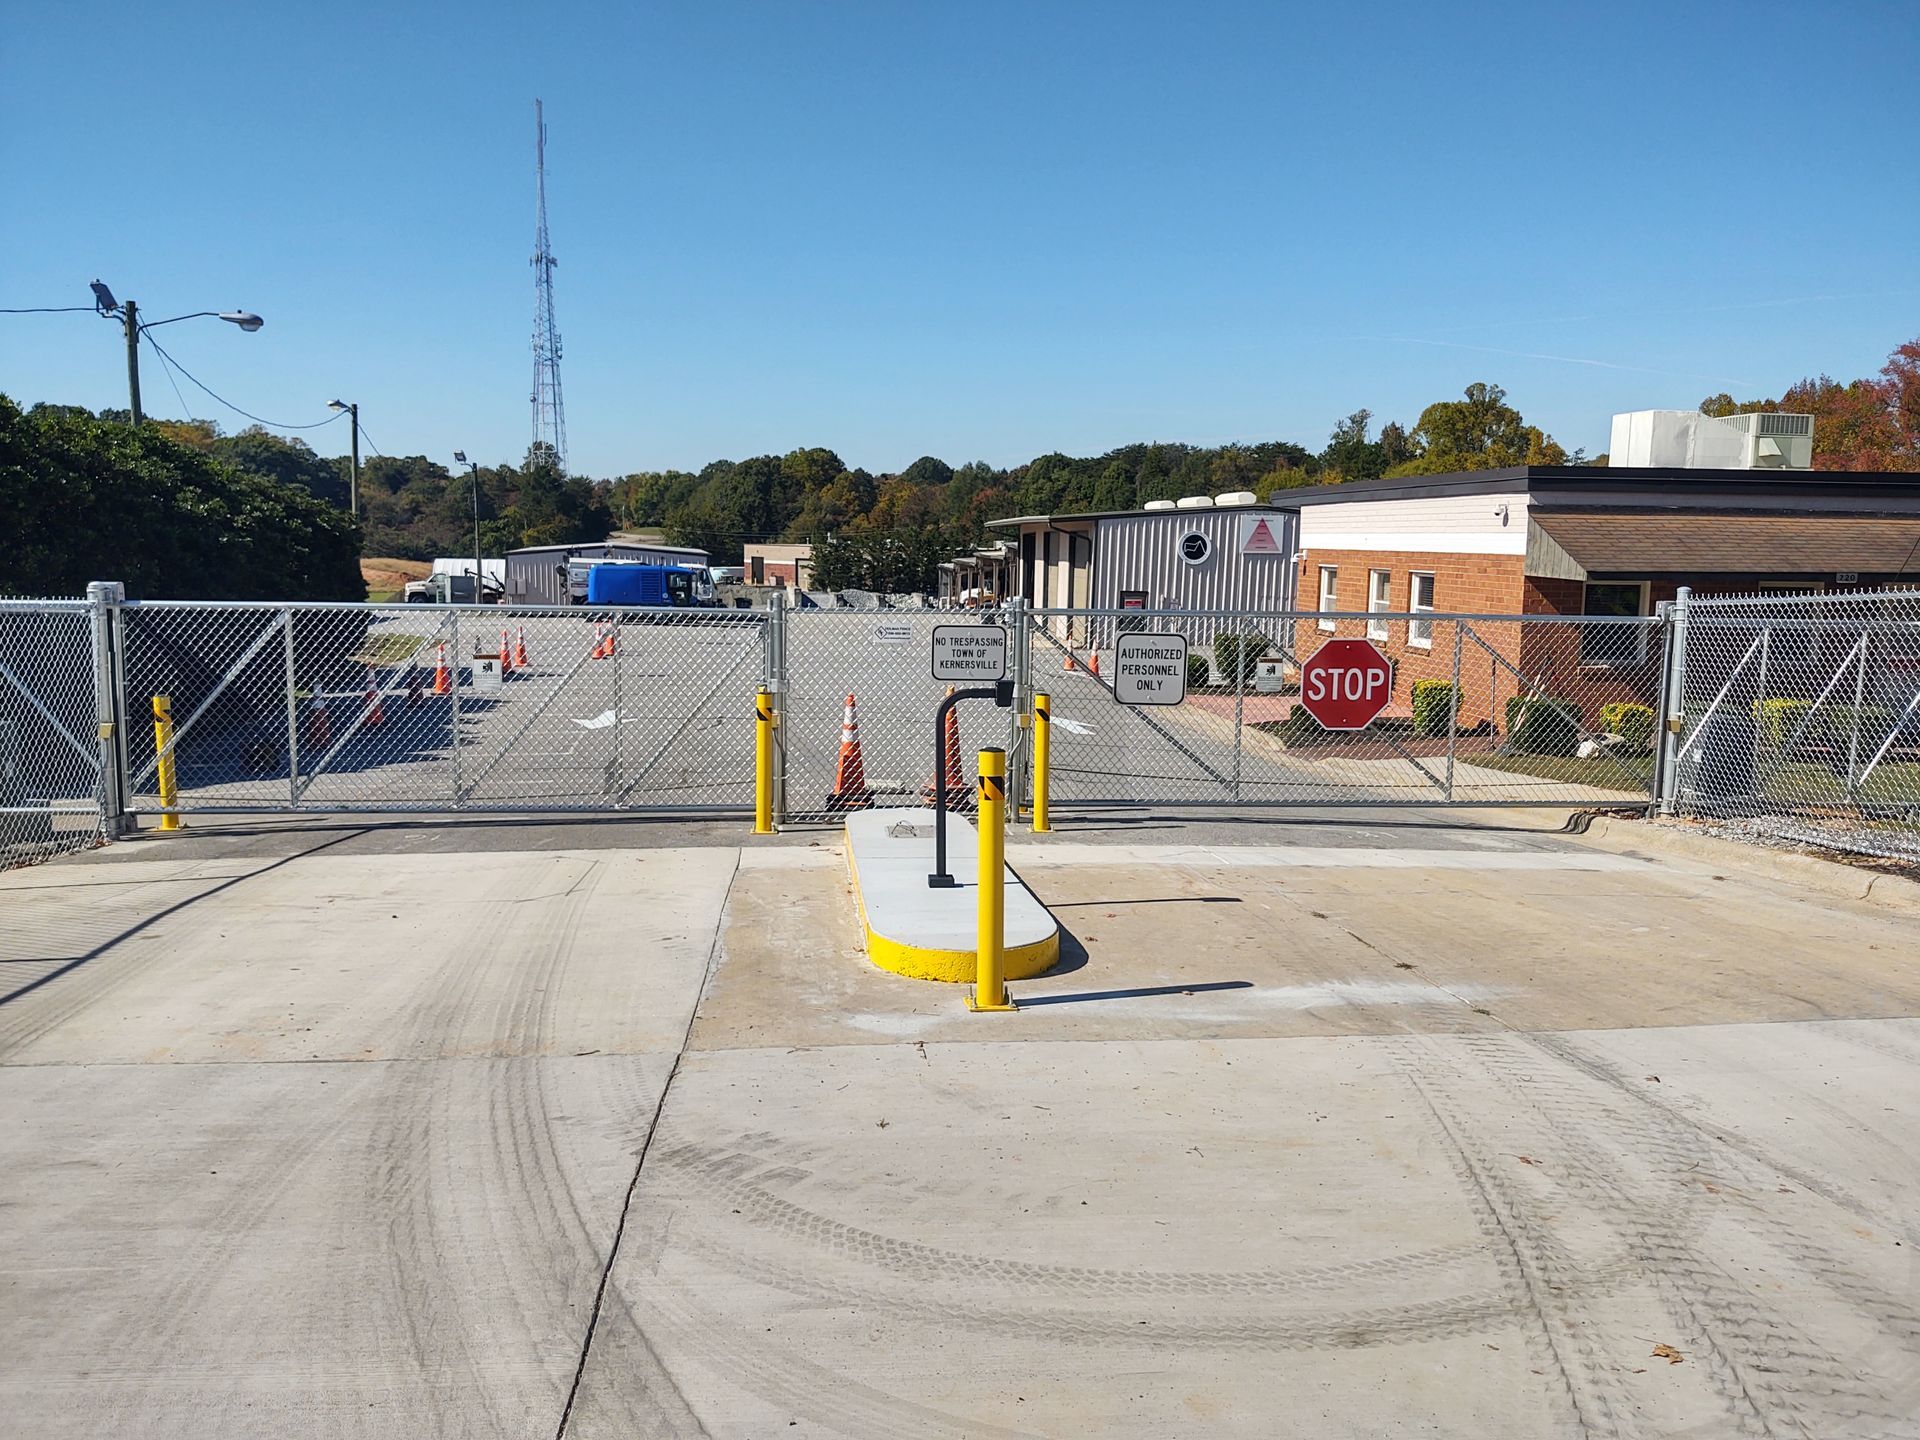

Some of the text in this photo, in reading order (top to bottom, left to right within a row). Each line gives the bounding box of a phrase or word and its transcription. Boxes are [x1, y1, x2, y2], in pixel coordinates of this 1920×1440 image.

[935, 637, 1004, 647] NO TRESPASSING
[952, 649, 987, 658] TOWN OF
[1120, 648, 1183, 660] AUTHORIZED
[939, 660, 998, 670] KERNERSVILLE
[1121, 664, 1180, 676] PERSONNEL
[1136, 679, 1163, 691] ONLY
[1307, 667, 1385, 701] STOP
